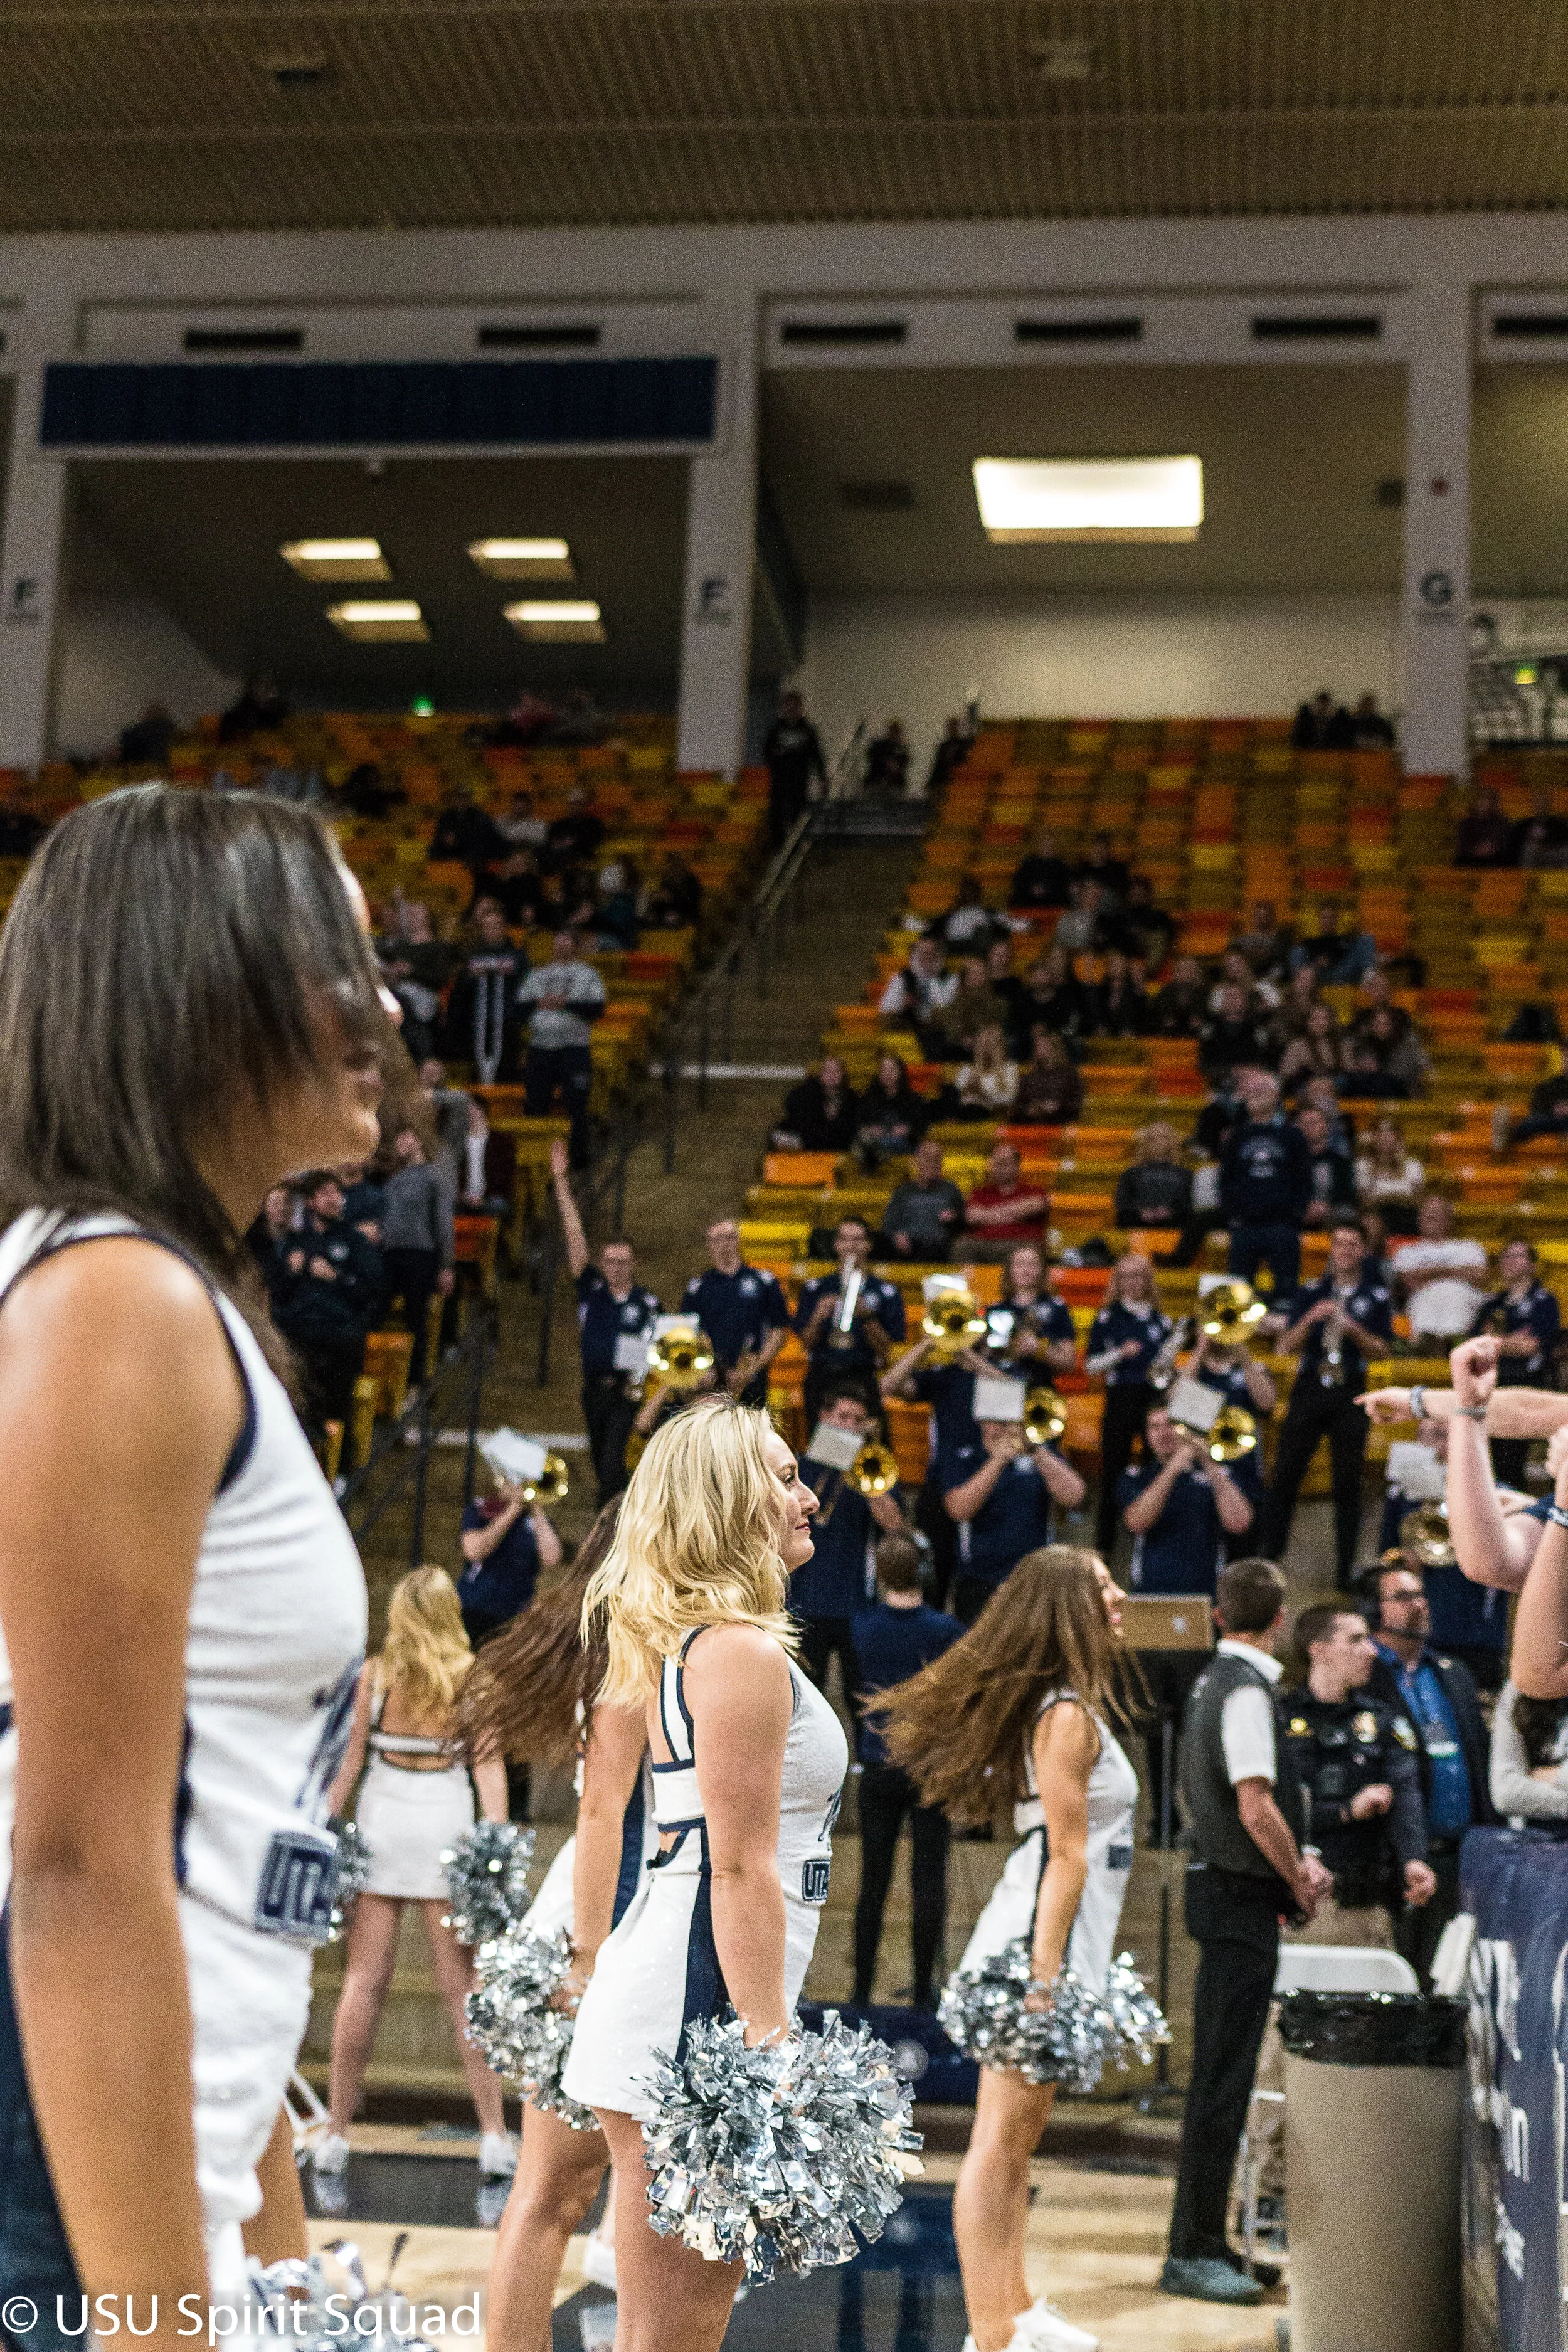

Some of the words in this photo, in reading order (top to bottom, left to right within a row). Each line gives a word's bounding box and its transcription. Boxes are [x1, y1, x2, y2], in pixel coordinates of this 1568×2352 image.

[14, 577, 37, 608] F
[701, 578, 725, 610] F
[1420, 571, 1453, 605] G
